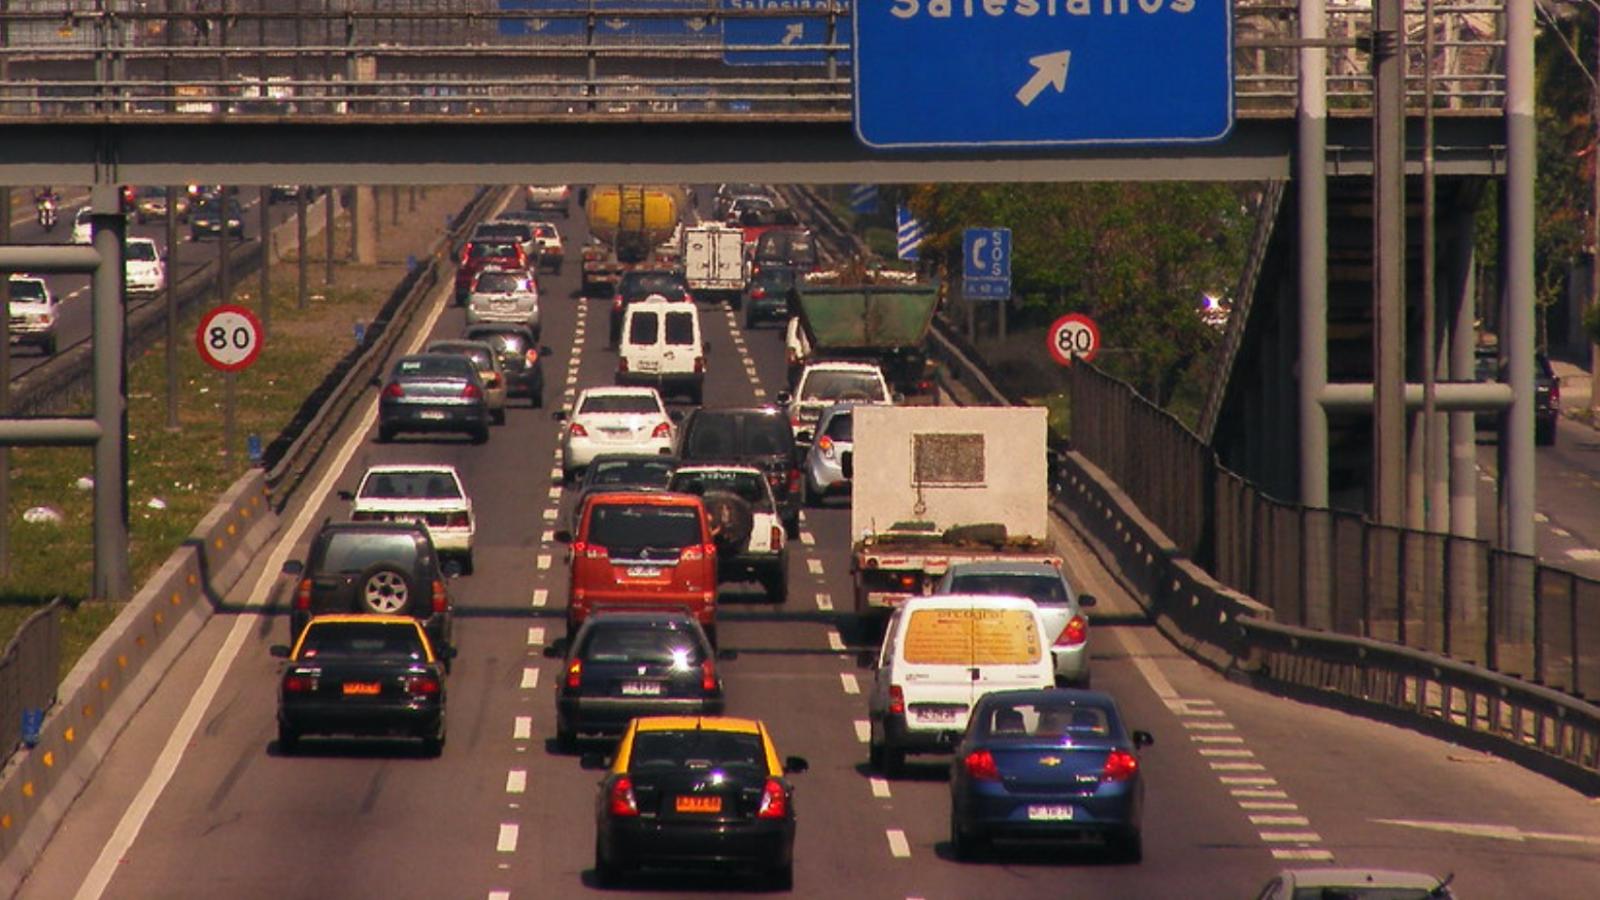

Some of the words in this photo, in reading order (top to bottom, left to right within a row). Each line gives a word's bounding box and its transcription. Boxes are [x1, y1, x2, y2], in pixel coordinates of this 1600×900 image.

[992, 231, 1003, 276] SOS
[210, 326, 250, 350] 80
[1059, 328, 1091, 352] 80
